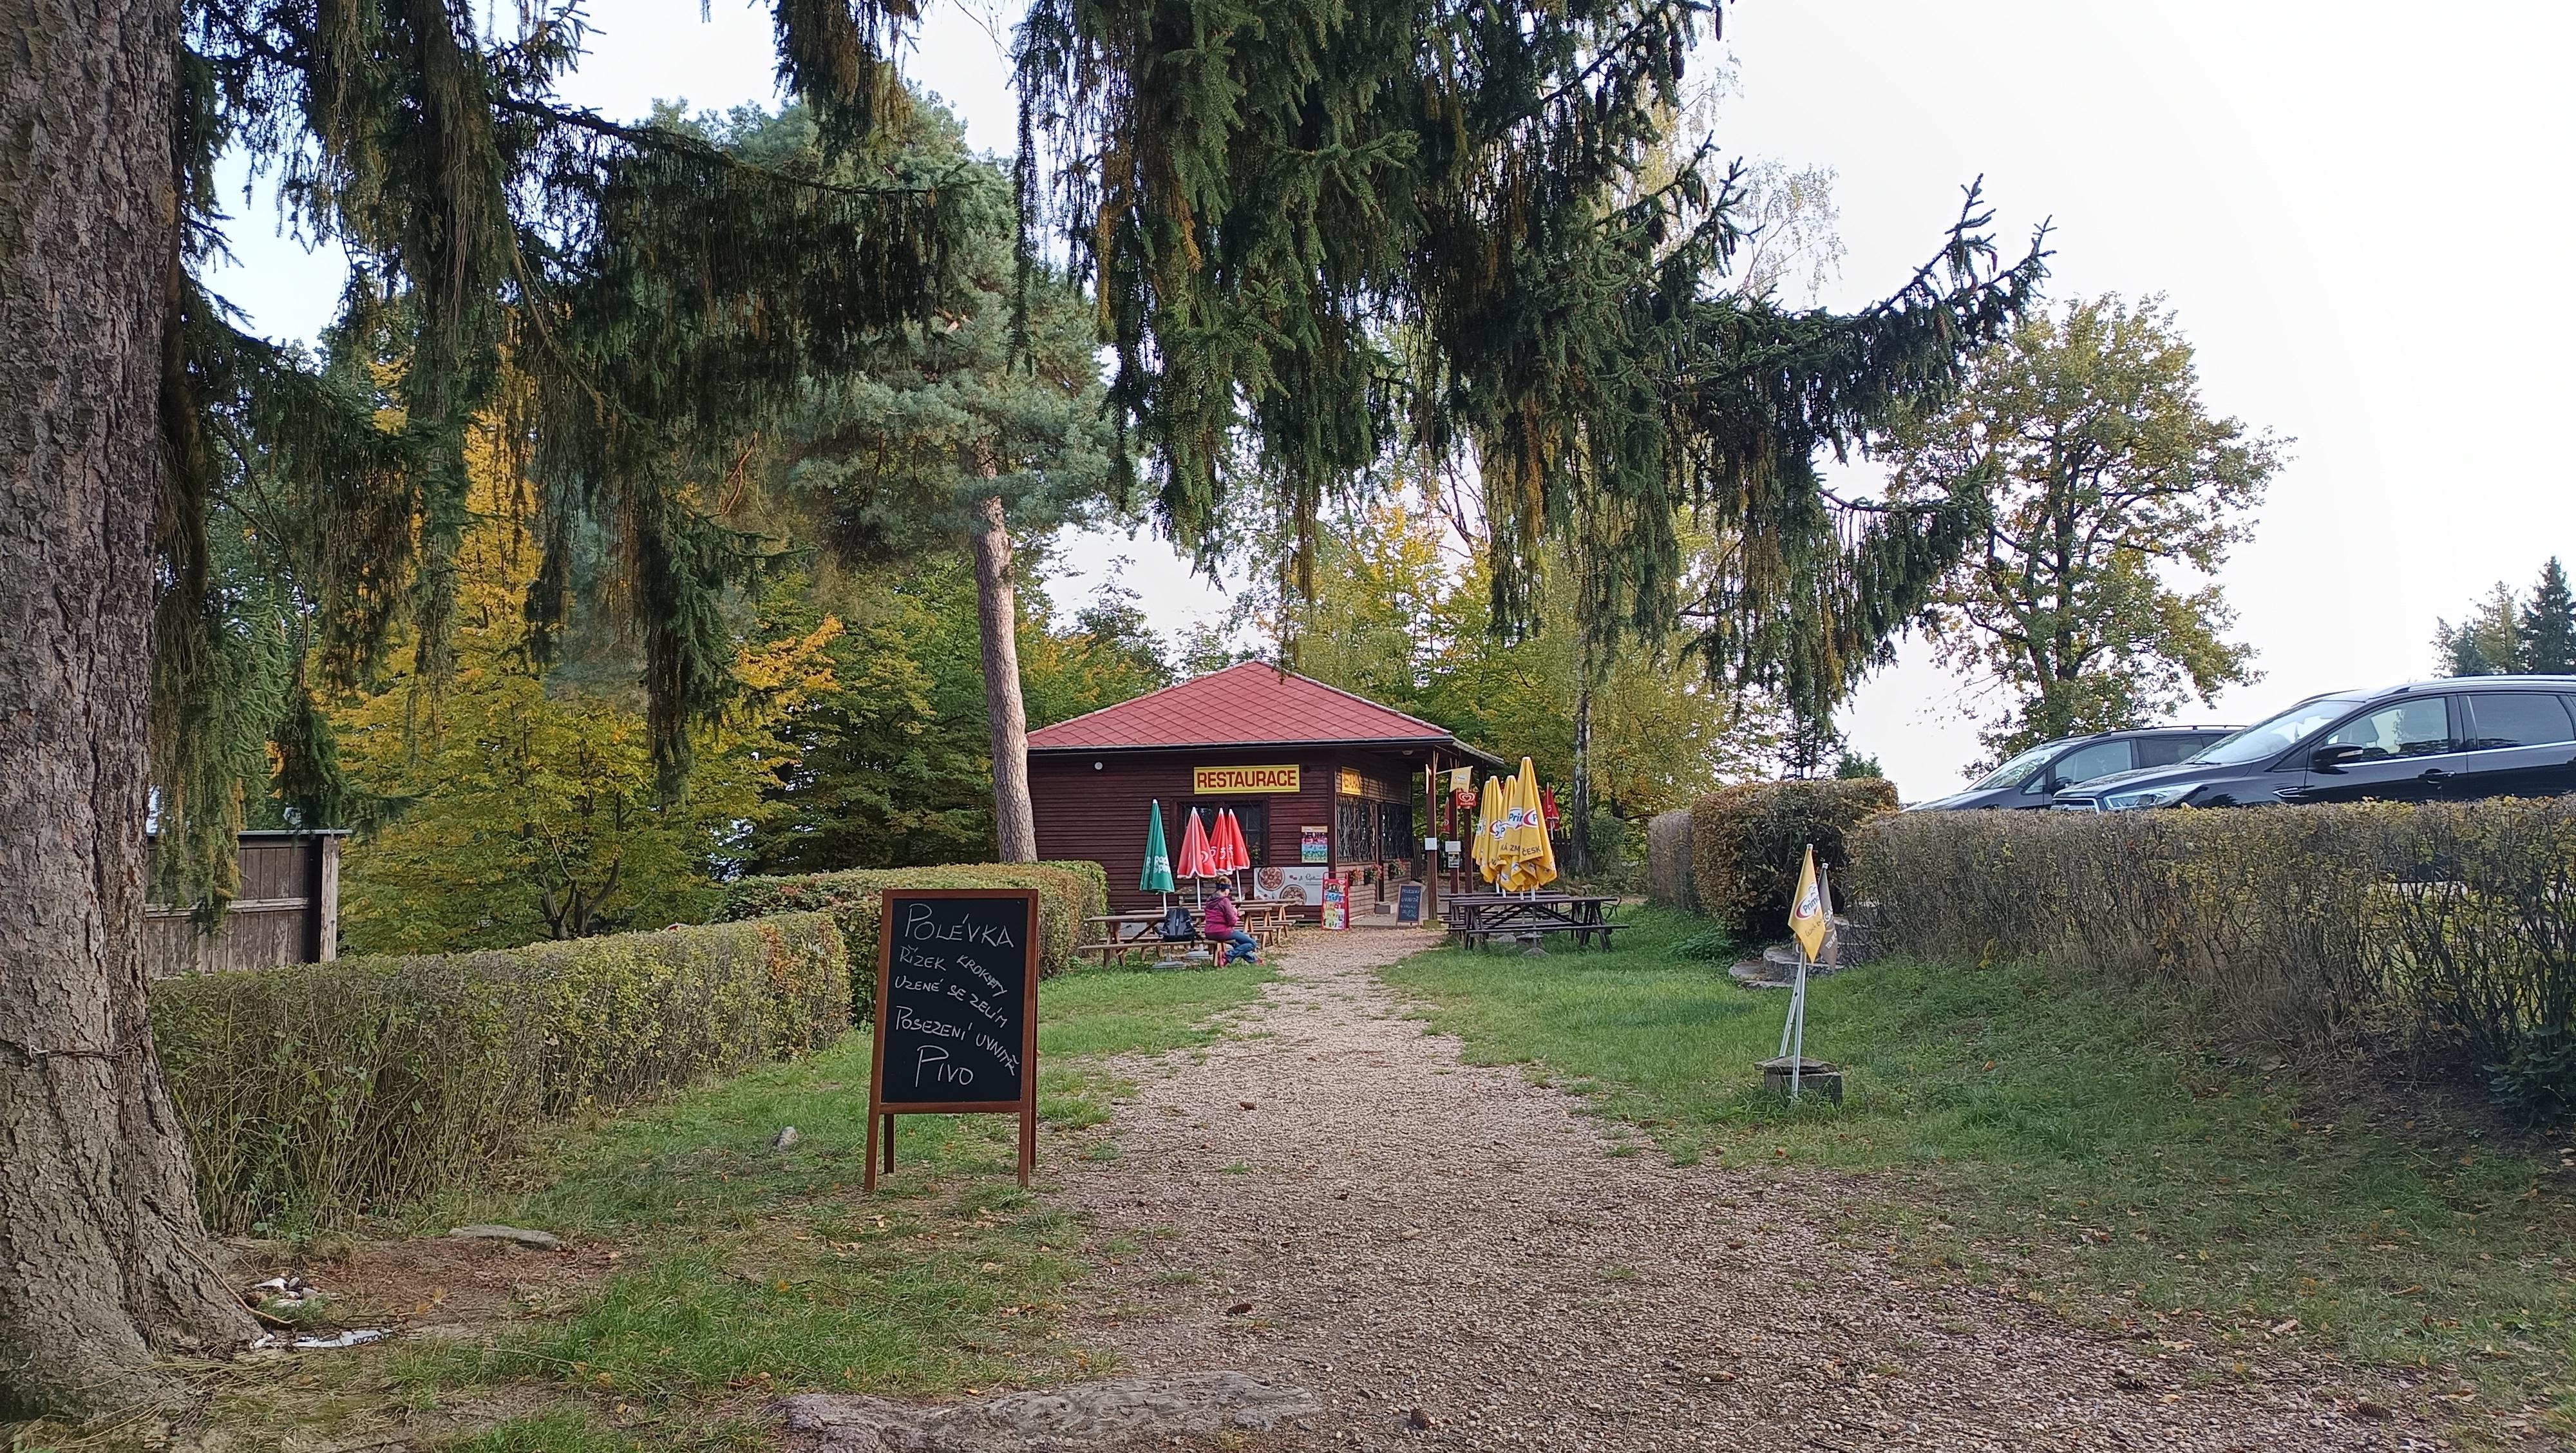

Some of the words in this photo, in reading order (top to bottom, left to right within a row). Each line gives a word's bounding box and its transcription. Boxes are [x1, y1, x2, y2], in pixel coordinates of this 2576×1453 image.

[1197, 770, 1296, 788] RESTAURACE
[905, 903, 1014, 947] POLÉVKA
[900, 944, 947, 971] ŘÍZEK
[895, 975, 943, 992] UZENÉ
[947, 984, 966, 1001] SE
[969, 993, 1008, 1029] ZELÍM
[896, 1005, 973, 1040] POSEZENÍ
[915, 1045, 974, 1088] PIVO
